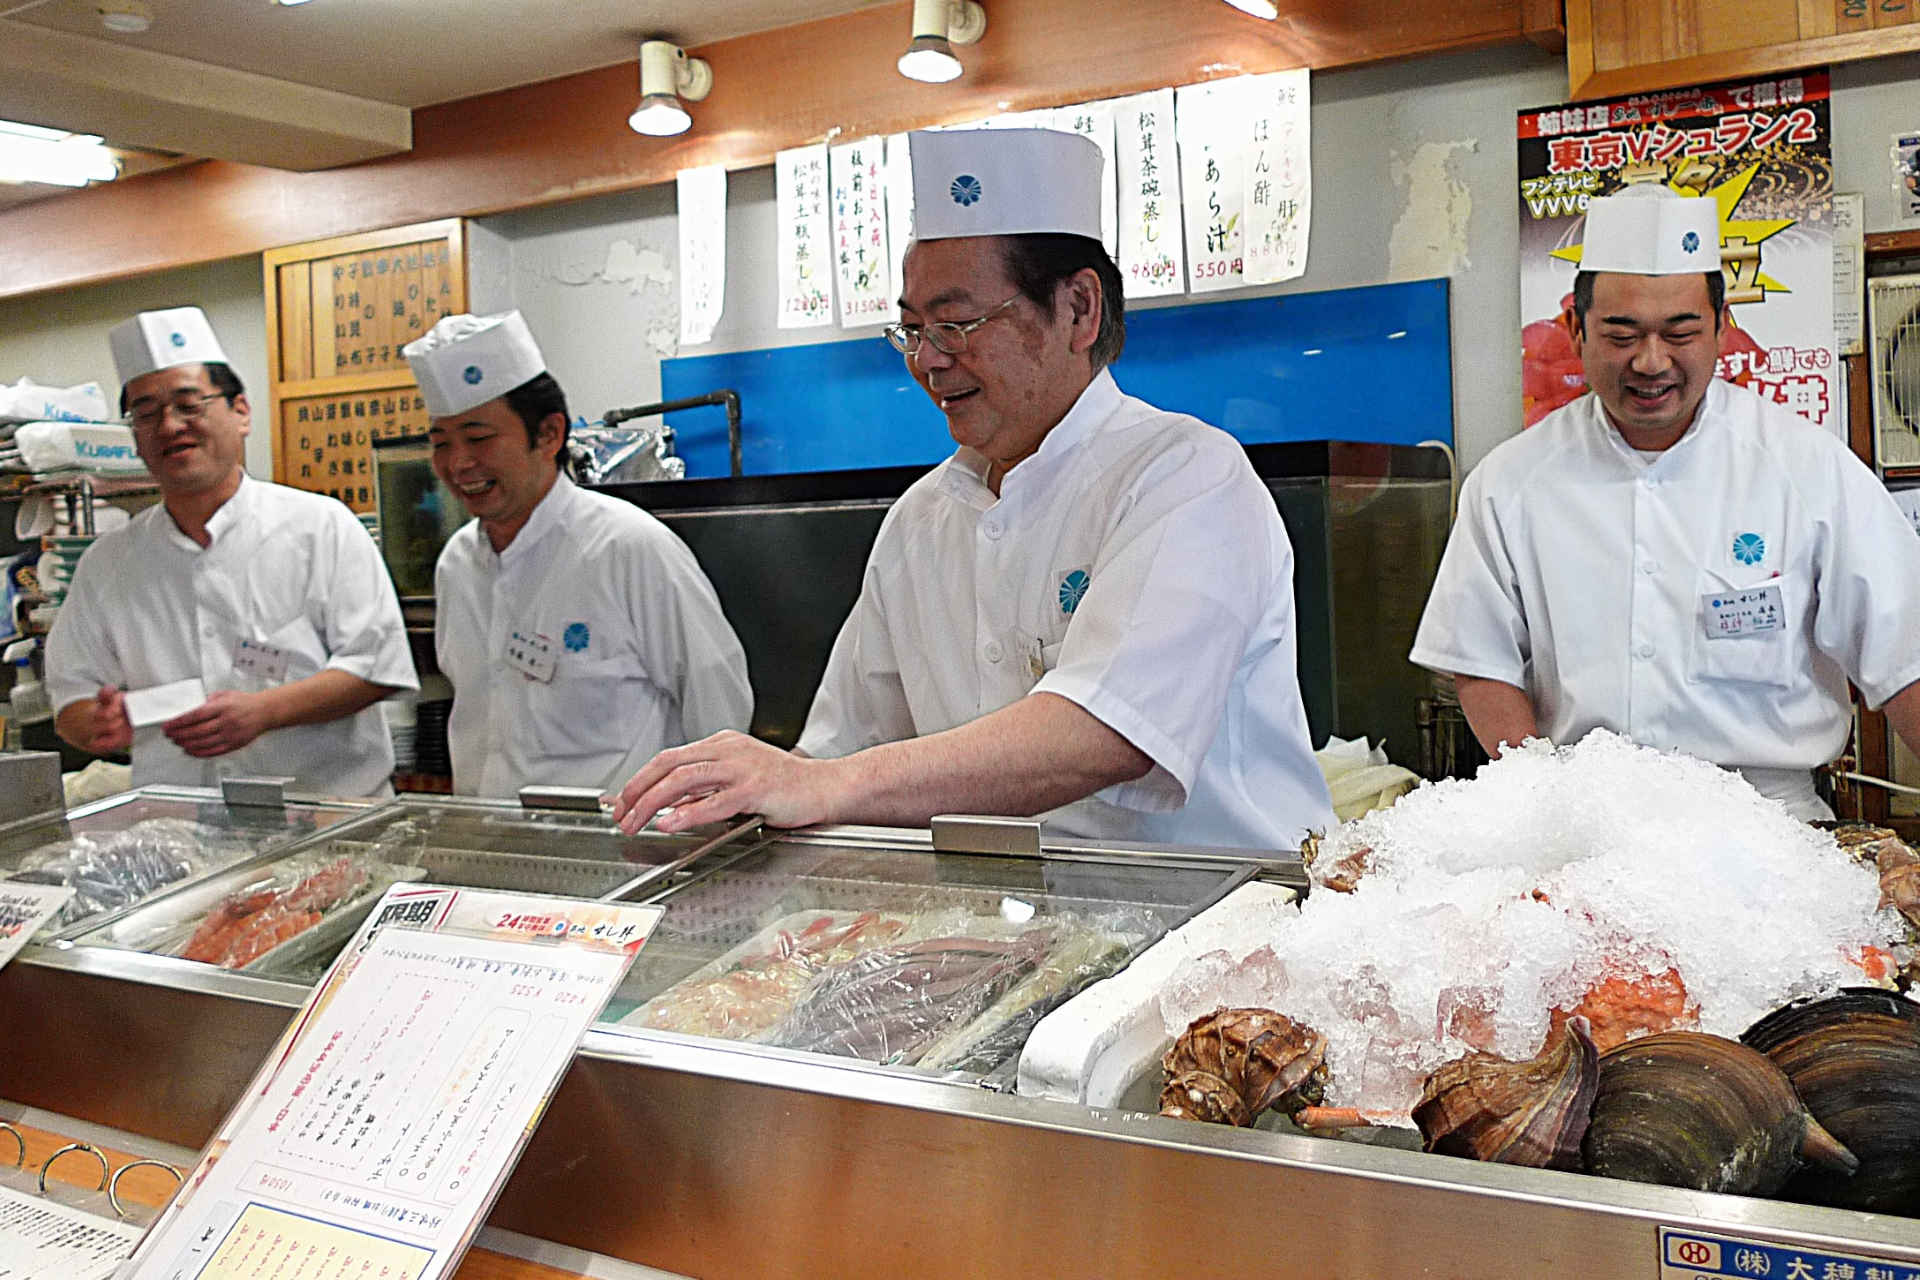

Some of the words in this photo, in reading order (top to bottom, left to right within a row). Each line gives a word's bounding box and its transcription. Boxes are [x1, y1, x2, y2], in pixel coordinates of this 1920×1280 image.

[1537, 105, 1609, 137] 姉妹店
[1549, 109, 1817, 174] 東京Vシュラン2
[1138, 111, 1161, 243] 松茸茶碗蒸し
[1522, 172, 1597, 198] フジテレビ
[1205, 157, 1229, 253] あら汁
[1131, 261, 1176, 279] 980円
[1195, 259, 1244, 280] 550円
[333, 263, 348, 369] やりいか
[496, 913, 521, 929] 24
[367, 1122, 412, 1182] デザート
